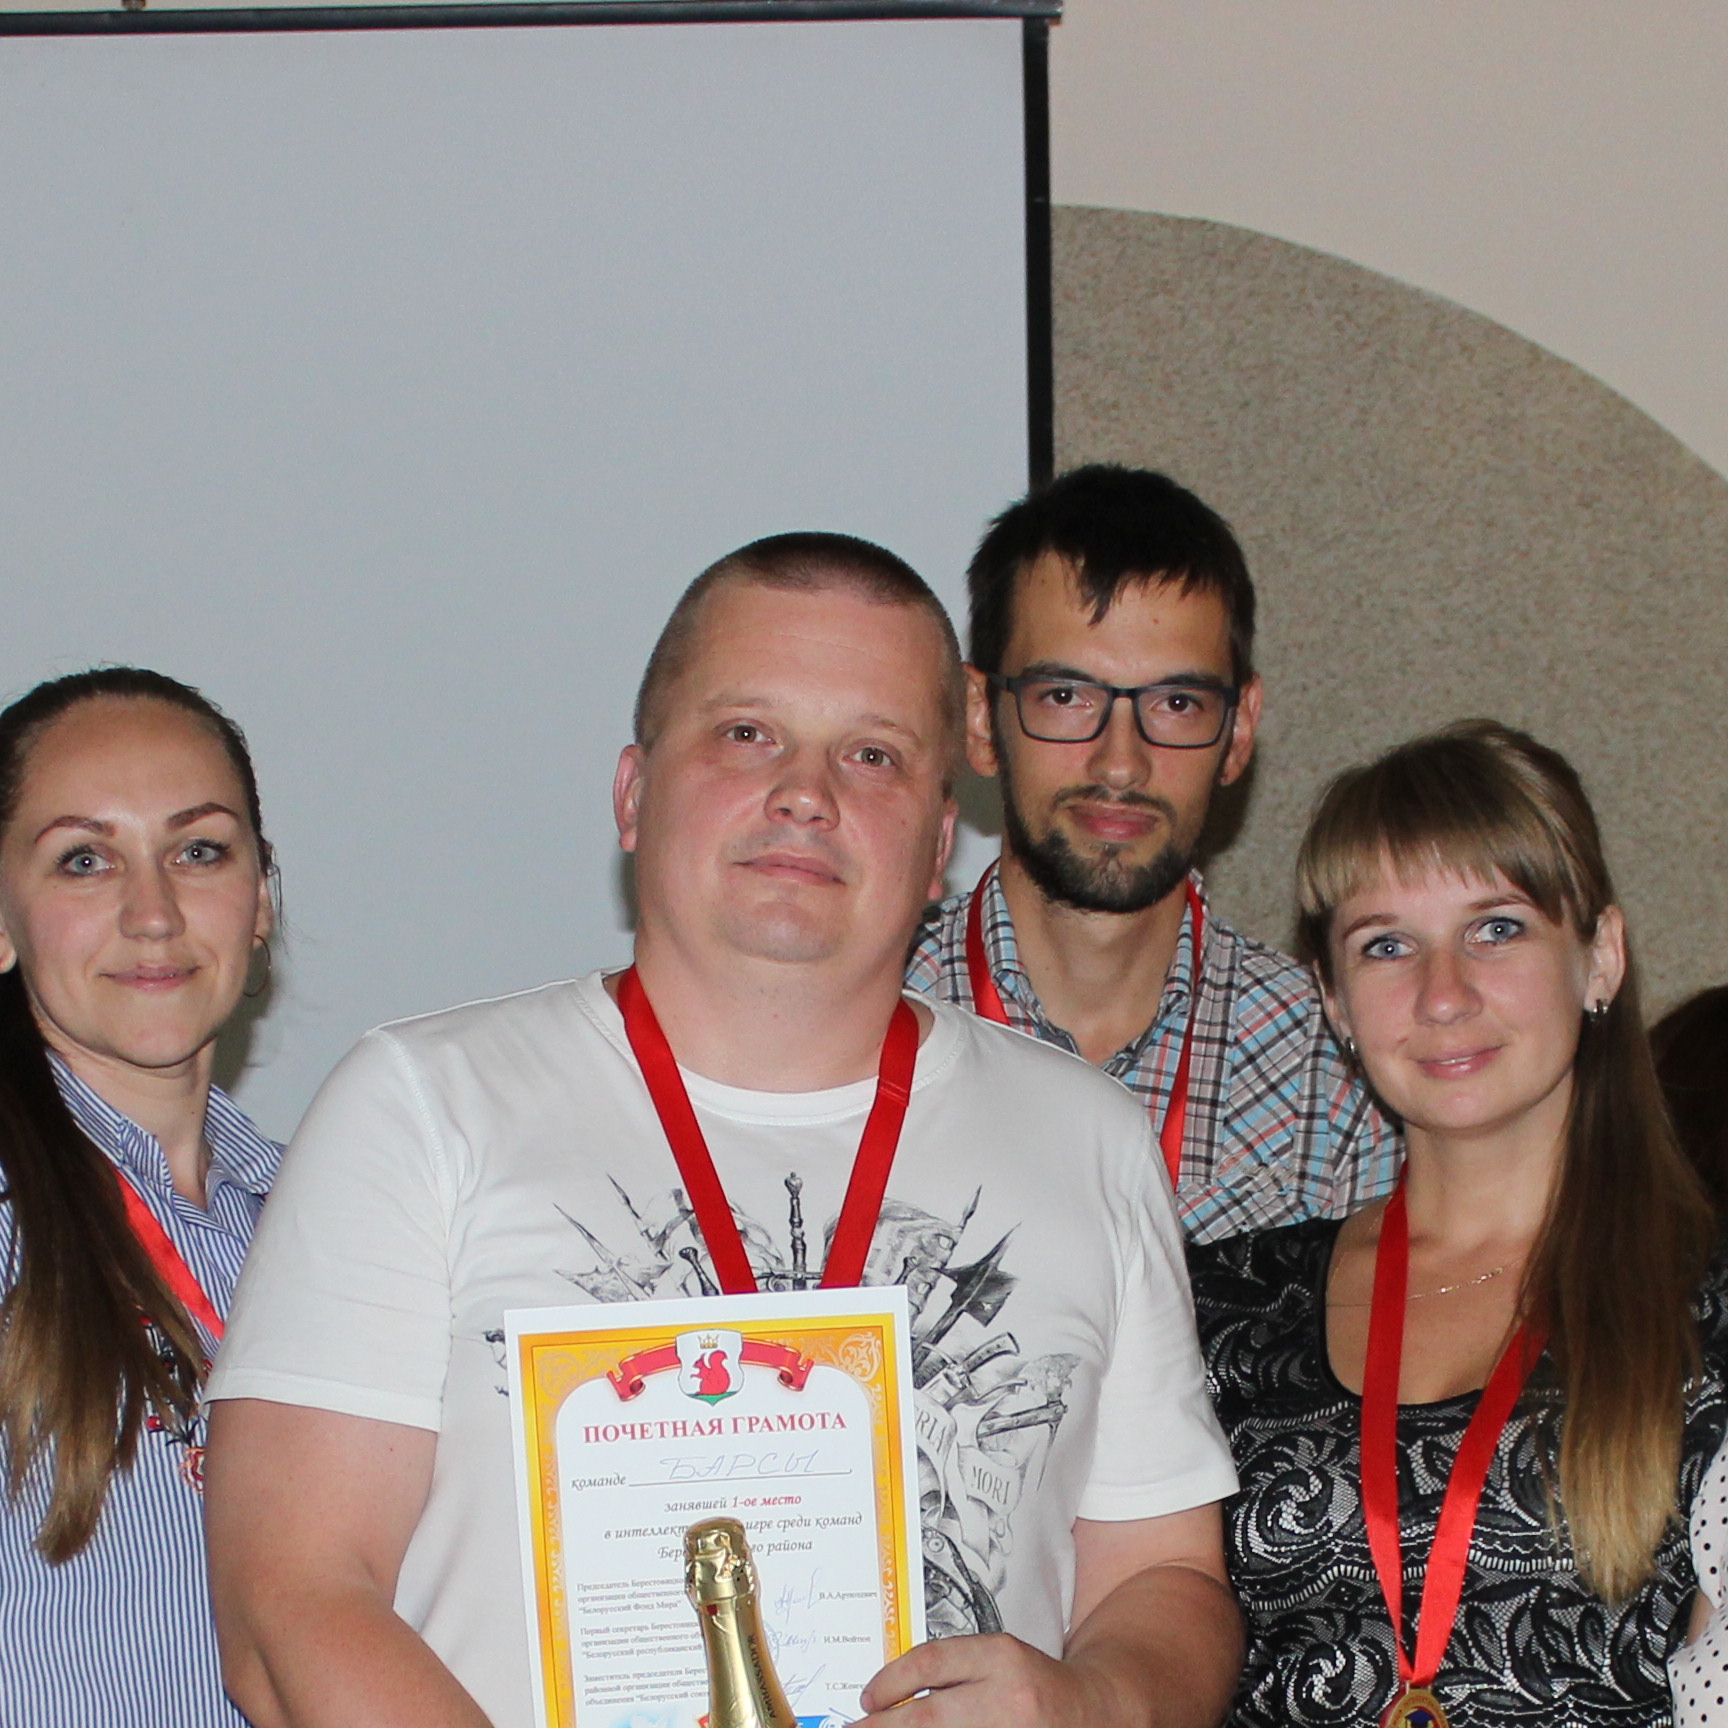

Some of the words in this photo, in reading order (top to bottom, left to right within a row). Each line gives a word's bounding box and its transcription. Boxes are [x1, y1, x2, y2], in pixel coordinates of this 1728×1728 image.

[583, 1417, 724, 1443] ПОЧЕТНАЯ
[731, 1412, 847, 1434] ГРАМОТА
[915, 1407, 947, 1453] RIA
[571, 1472, 626, 1491] команде
[659, 1449, 819, 1480] БАРСЫ
[972, 1466, 1010, 1505] MORI
[664, 1497, 728, 1512] занявшей
[732, 1496, 757, 1508] 1-ое
[761, 1495, 802, 1506] место
[604, 1530, 611, 1539] в
[615, 1525, 689, 1539] интеллект
[745, 1520, 772, 1533] игре
[777, 1514, 811, 1532] среди
[815, 1512, 863, 1529] команд
[767, 1540, 813, 1556] района
